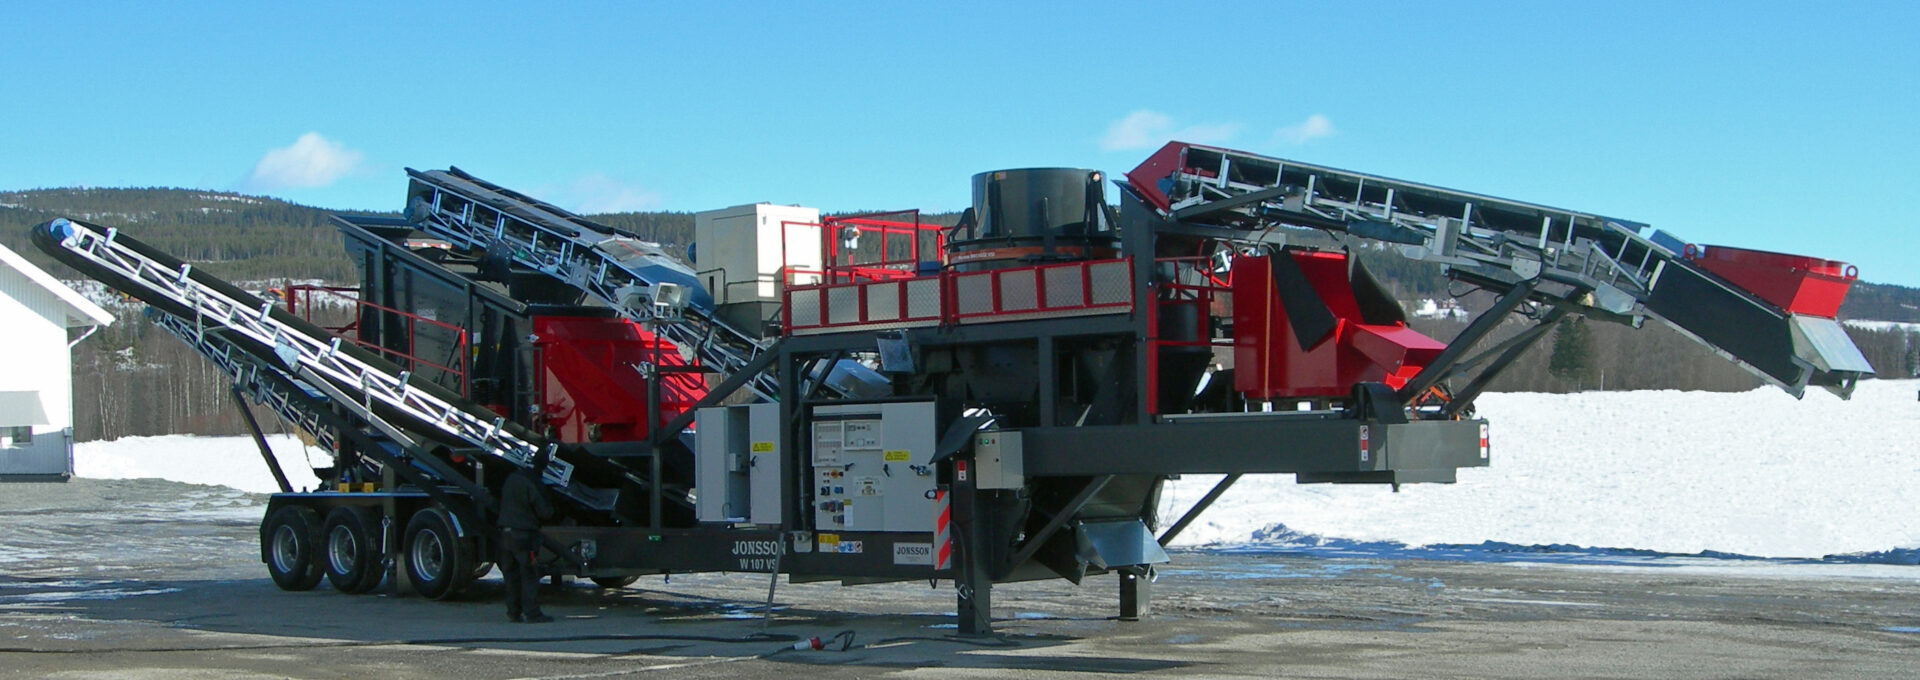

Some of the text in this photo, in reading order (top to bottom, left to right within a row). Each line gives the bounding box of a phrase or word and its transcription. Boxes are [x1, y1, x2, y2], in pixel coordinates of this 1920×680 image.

[732, 541, 786, 555] JONSSON
[896, 547, 929, 555] JONSSON
[739, 559, 749, 570] W
[751, 559, 764, 570] 107
